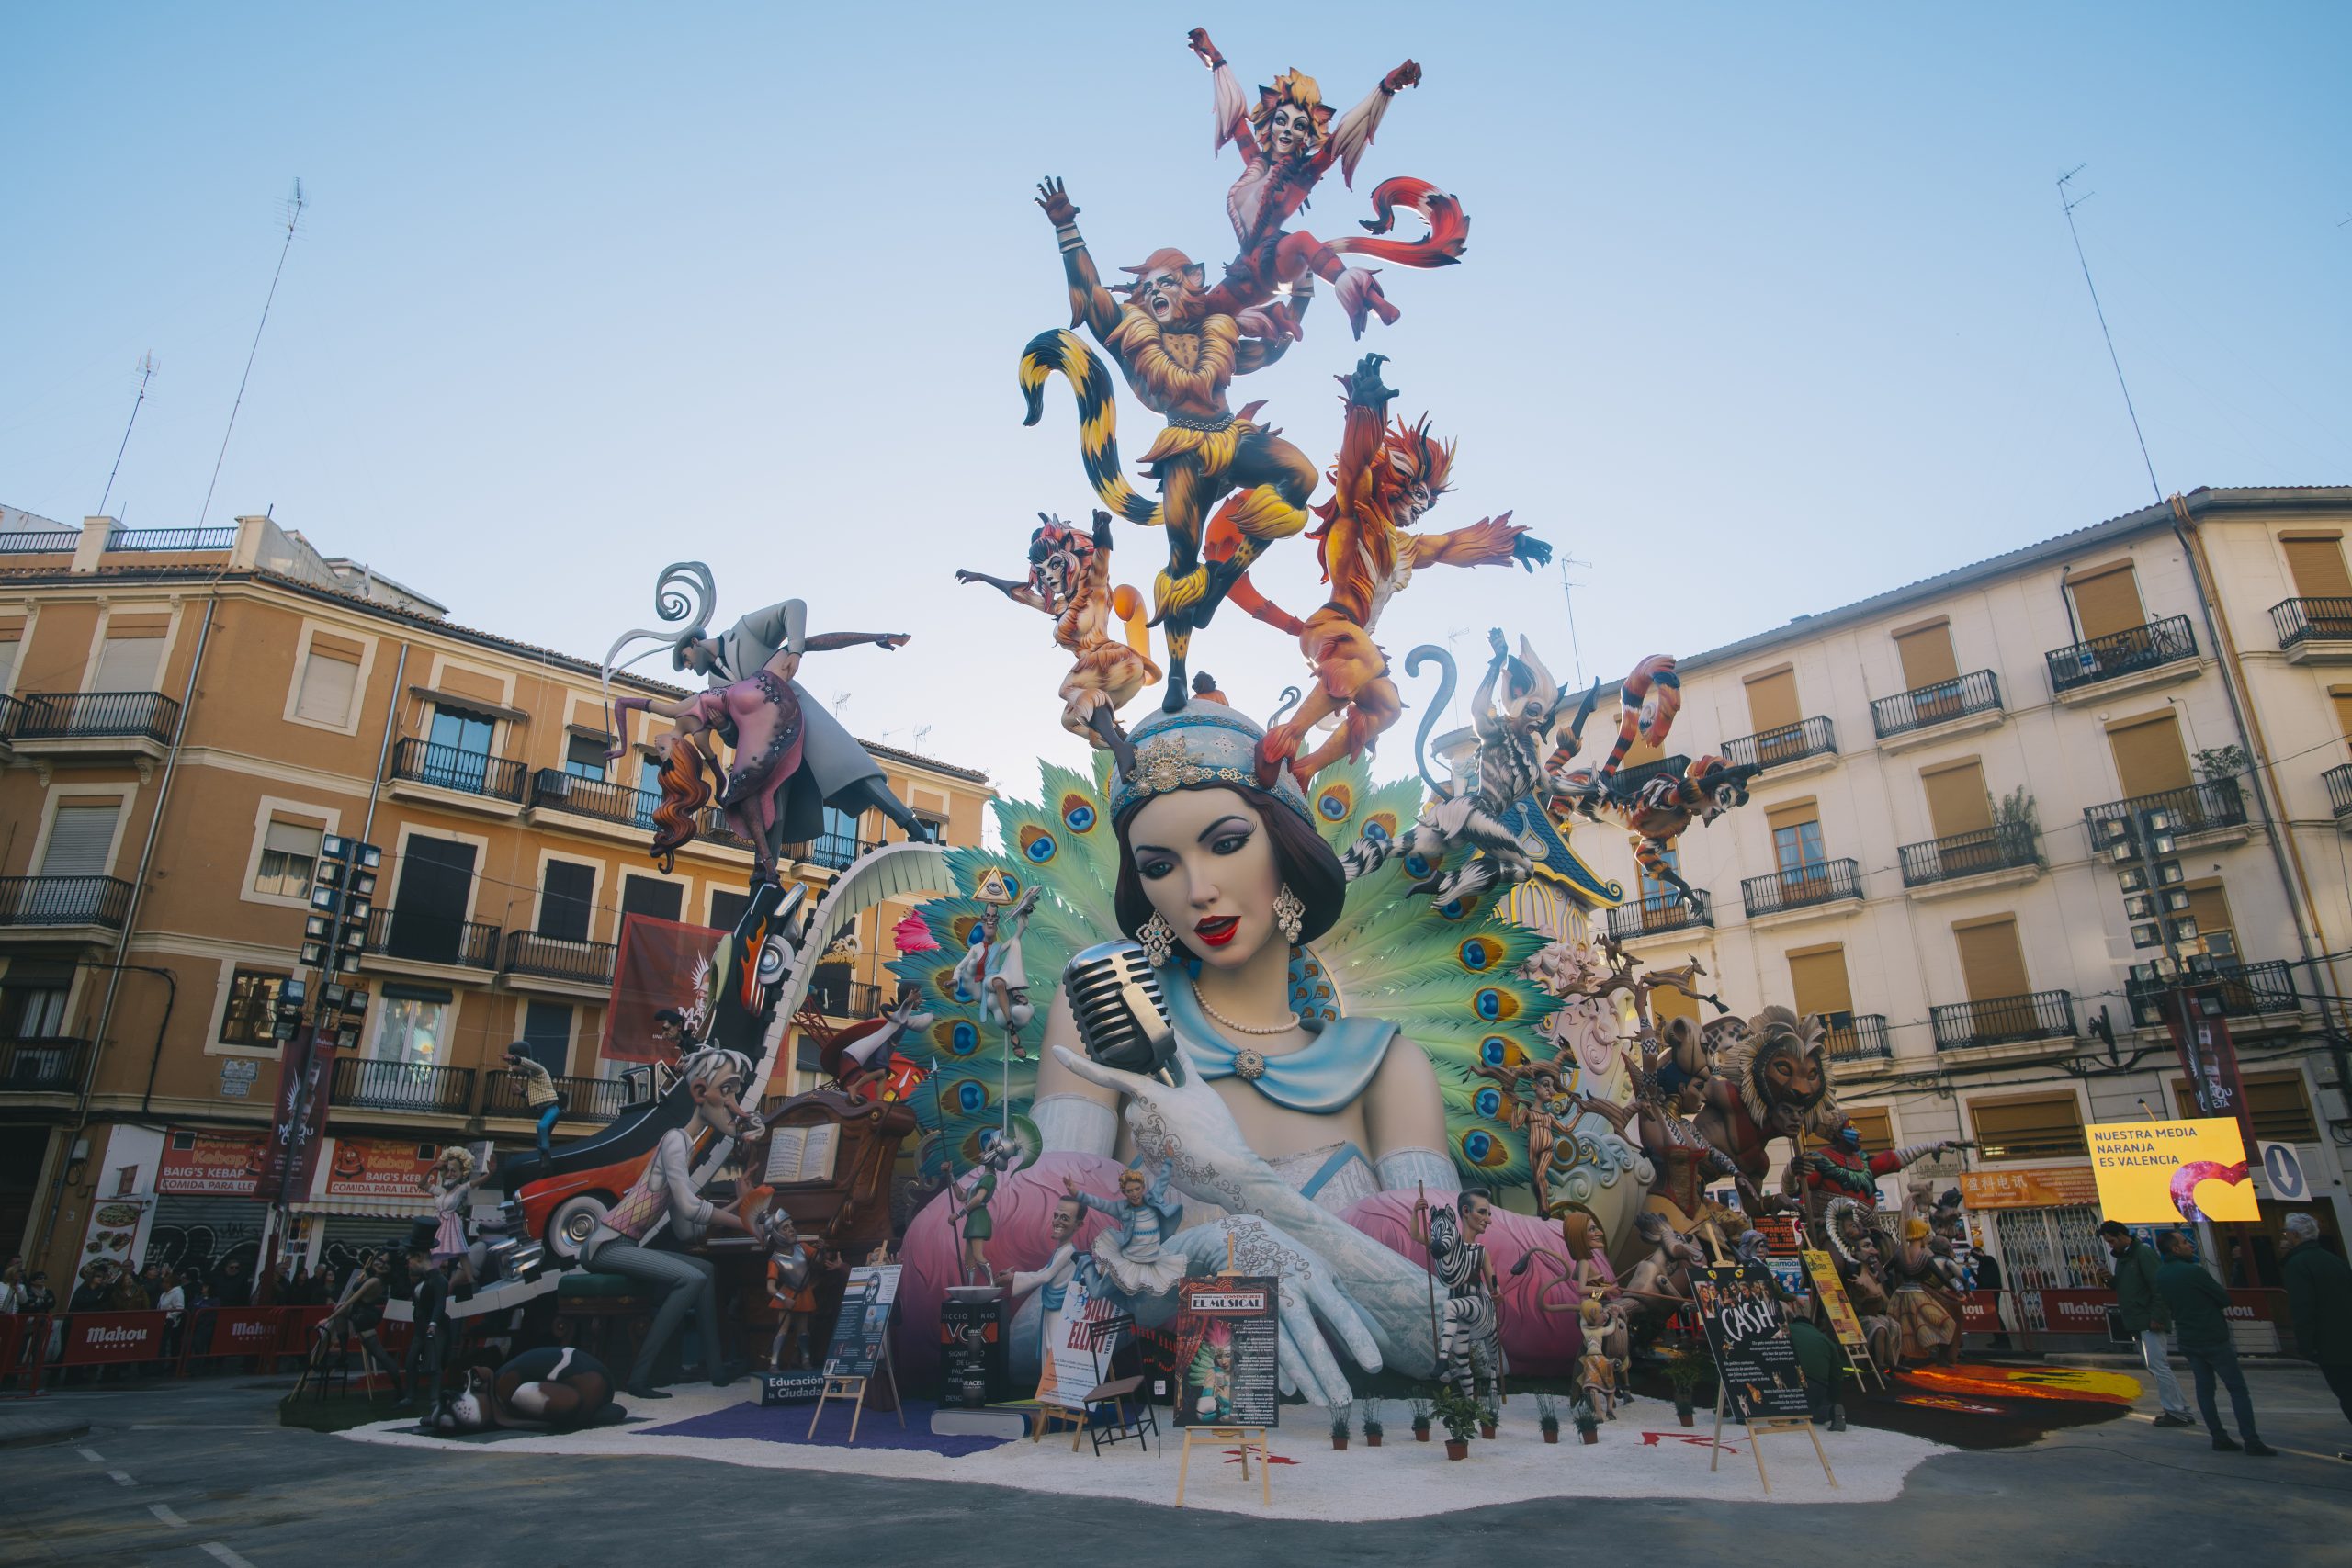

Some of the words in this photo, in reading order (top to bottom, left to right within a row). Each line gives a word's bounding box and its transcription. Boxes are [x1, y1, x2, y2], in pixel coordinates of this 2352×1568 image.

[2095, 1130, 2152, 1141] NUESTRA
[2156, 1127, 2198, 1139] MEDIA
[2098, 1143, 2154, 1154] NARANJA
[193, 1150, 247, 1168] Kebap
[368, 1155, 415, 1172] Kebap
[2099, 1156, 2114, 1168] ES
[2119, 1155, 2179, 1166] VALENCIA
[164, 1167, 203, 1177] BAIG'S
[208, 1168, 245, 1178] KEBAP
[366, 1172, 399, 1182] BAIG'S
[402, 1174, 435, 1183] KEBP
[163, 1179, 205, 1190] COMIDA
[209, 1181, 234, 1190] PARA
[333, 1183, 372, 1192] COMIDA
[374, 1185, 398, 1193] PARA
[1193, 1299, 1207, 1308] EL
[1210, 1298, 1262, 1308] MUSICAL
[2058, 1302, 2105, 1315] Maho
[87, 1325, 147, 1343] Mahou
[770, 1376, 824, 1387] Educación
